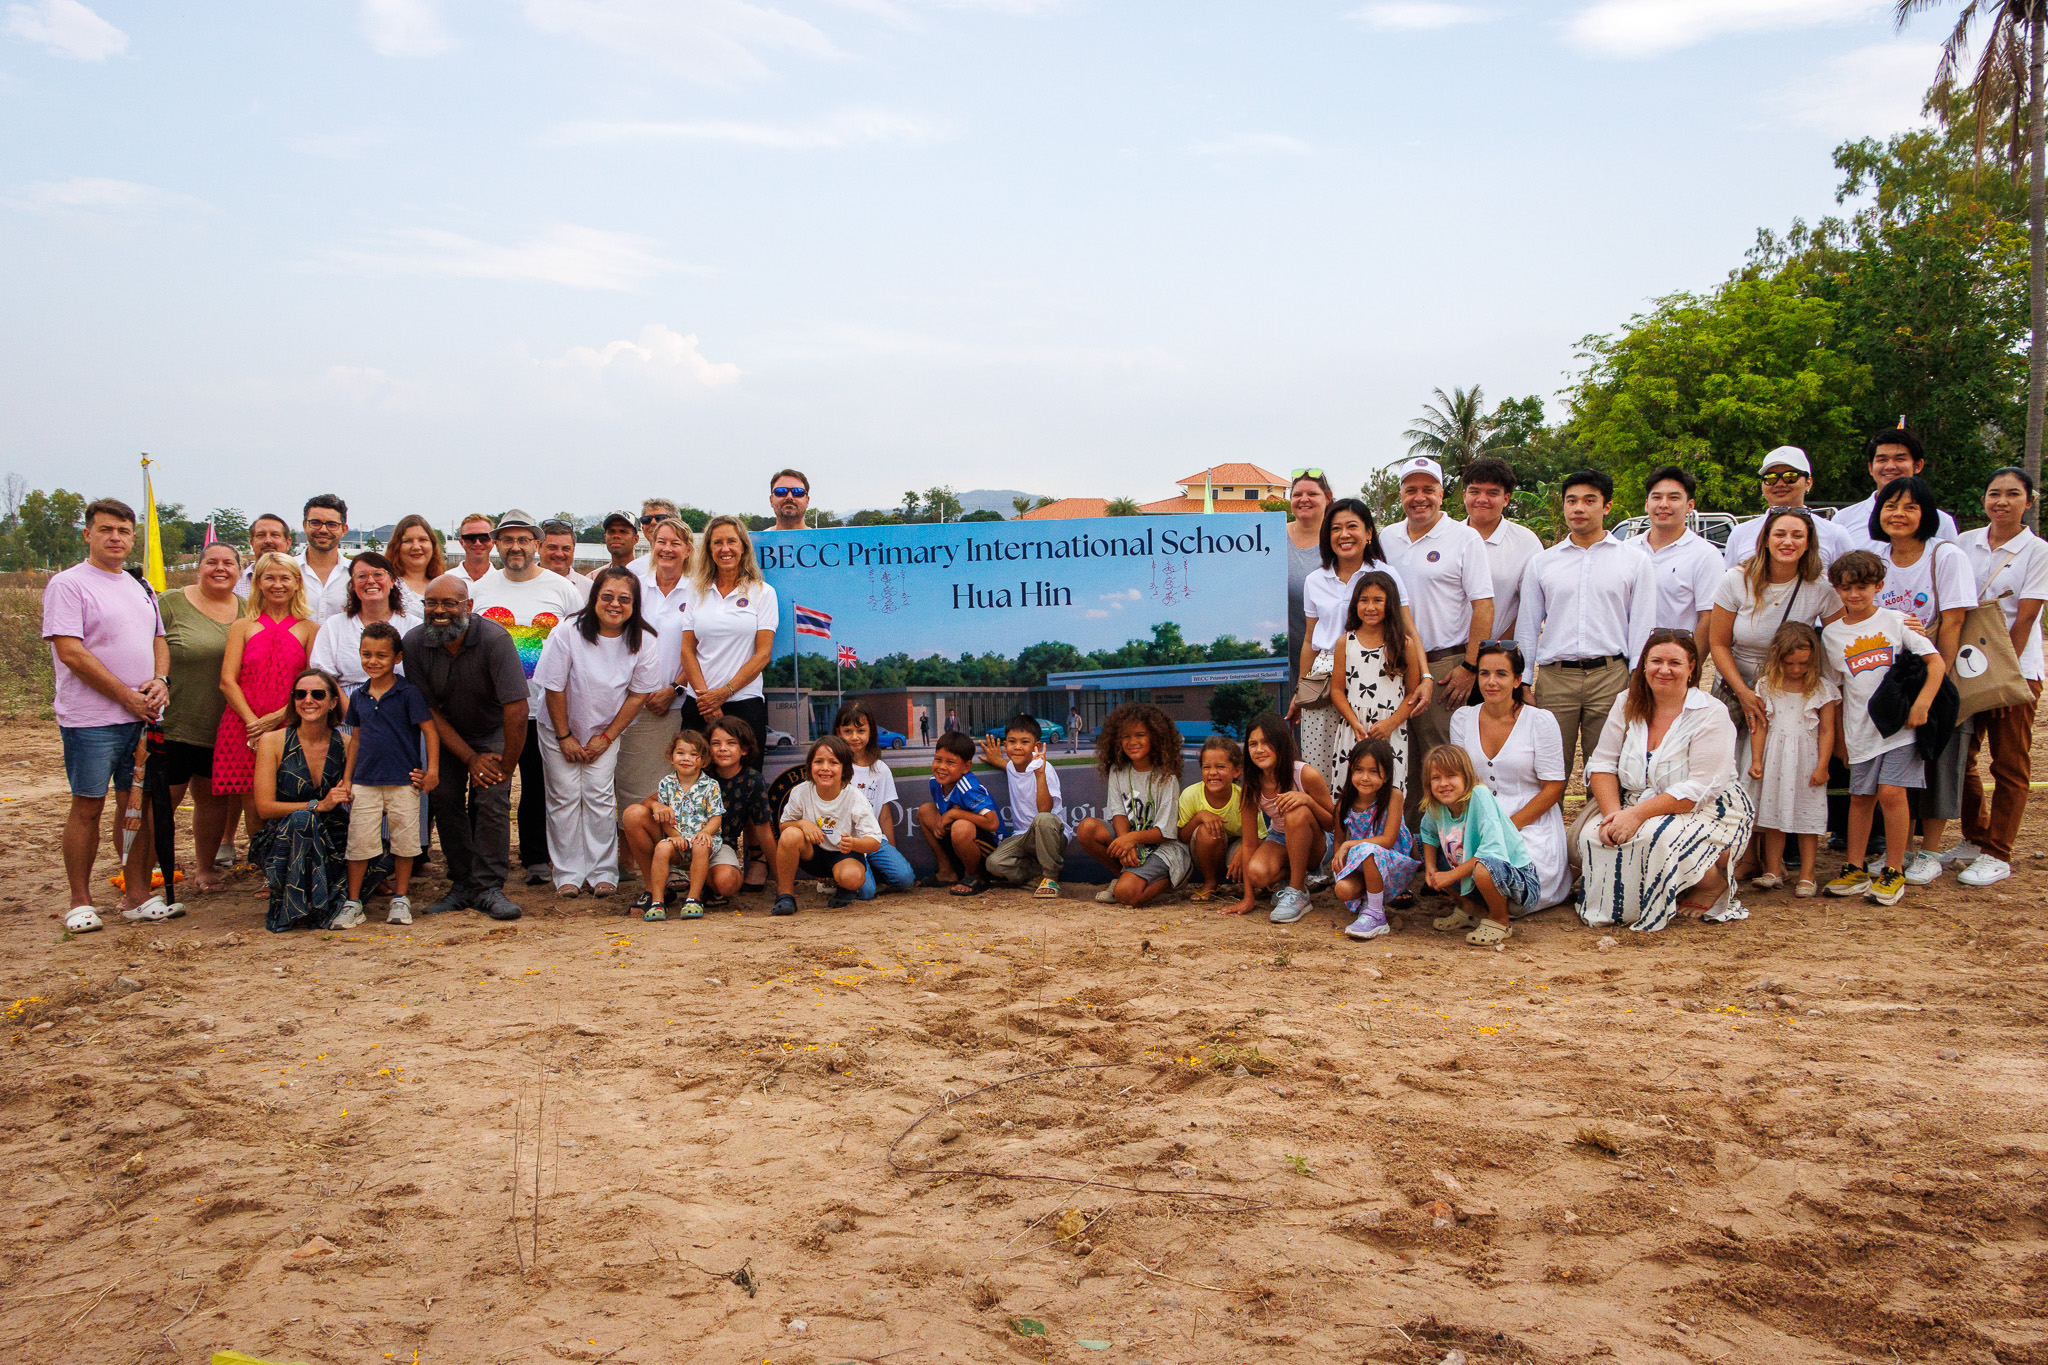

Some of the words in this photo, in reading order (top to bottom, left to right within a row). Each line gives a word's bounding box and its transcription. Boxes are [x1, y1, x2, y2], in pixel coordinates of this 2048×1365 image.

[759, 543, 841, 570] BECC
[847, 541, 960, 569] Primary
[967, 528, 1153, 562] International
[1161, 524, 1270, 556] School,
[952, 583, 1013, 609] Hua
[1020, 581, 1072, 607] Hin
[1882, 590, 1896, 600] GIVE
[1229, 671, 1260, 680] International
